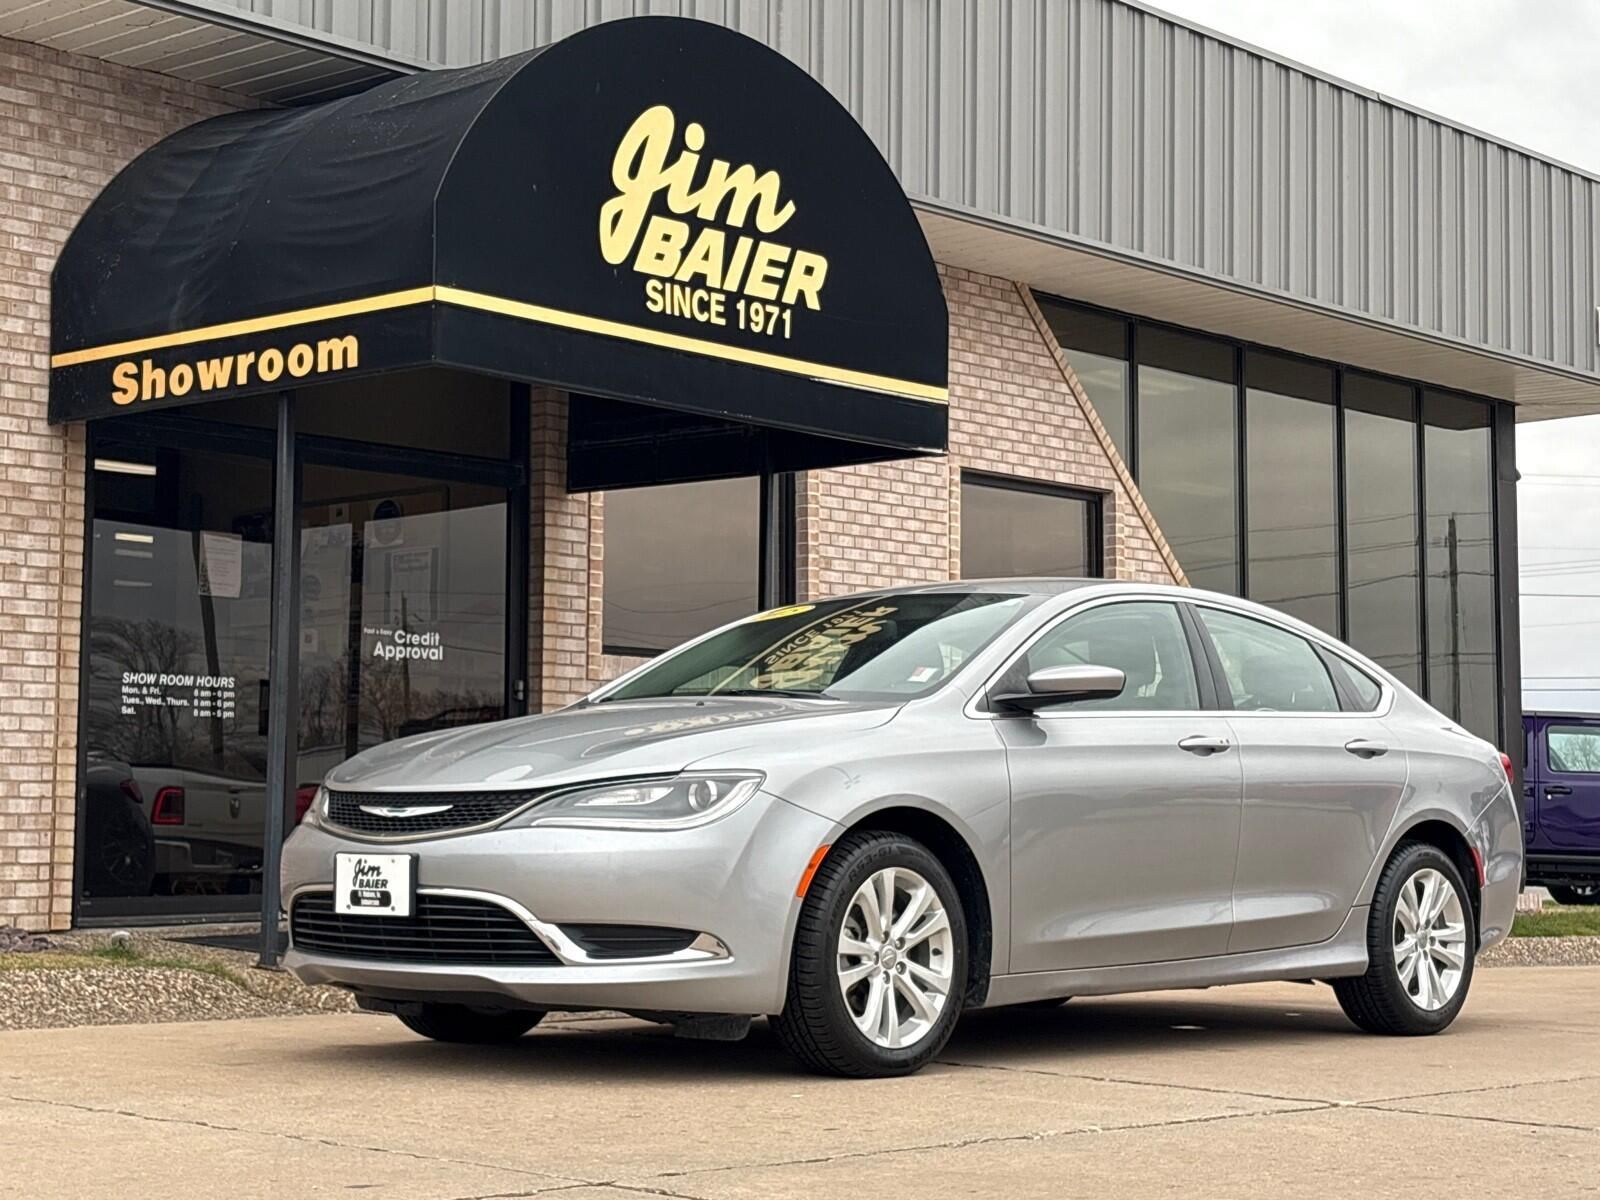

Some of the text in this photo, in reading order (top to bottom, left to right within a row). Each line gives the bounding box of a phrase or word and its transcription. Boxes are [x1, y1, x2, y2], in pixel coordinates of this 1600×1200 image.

[600, 105, 796, 265] Jim
[633, 215, 828, 311] BAIER
[645, 279, 792, 339] SINCE 1971
[112, 335, 358, 405] Showroom
[394, 629, 440, 646] Credit
[373, 640, 443, 660] Approval
[122, 671, 235, 688] SHOW ROOM HOURS
[122, 685, 140, 694] Mon.
[149, 686, 162, 695] Fri.
[223, 690, 235, 700] pm
[166, 697, 190, 706] Thurs.
[200, 699, 211, 707] am
[223, 700, 235, 710] pm
[121, 706, 136, 715] Sat.
[200, 710, 211, 718] am
[223, 711, 235, 720] pm
[352, 858, 382, 888] Jim
[358, 878, 388, 889] BAIER
